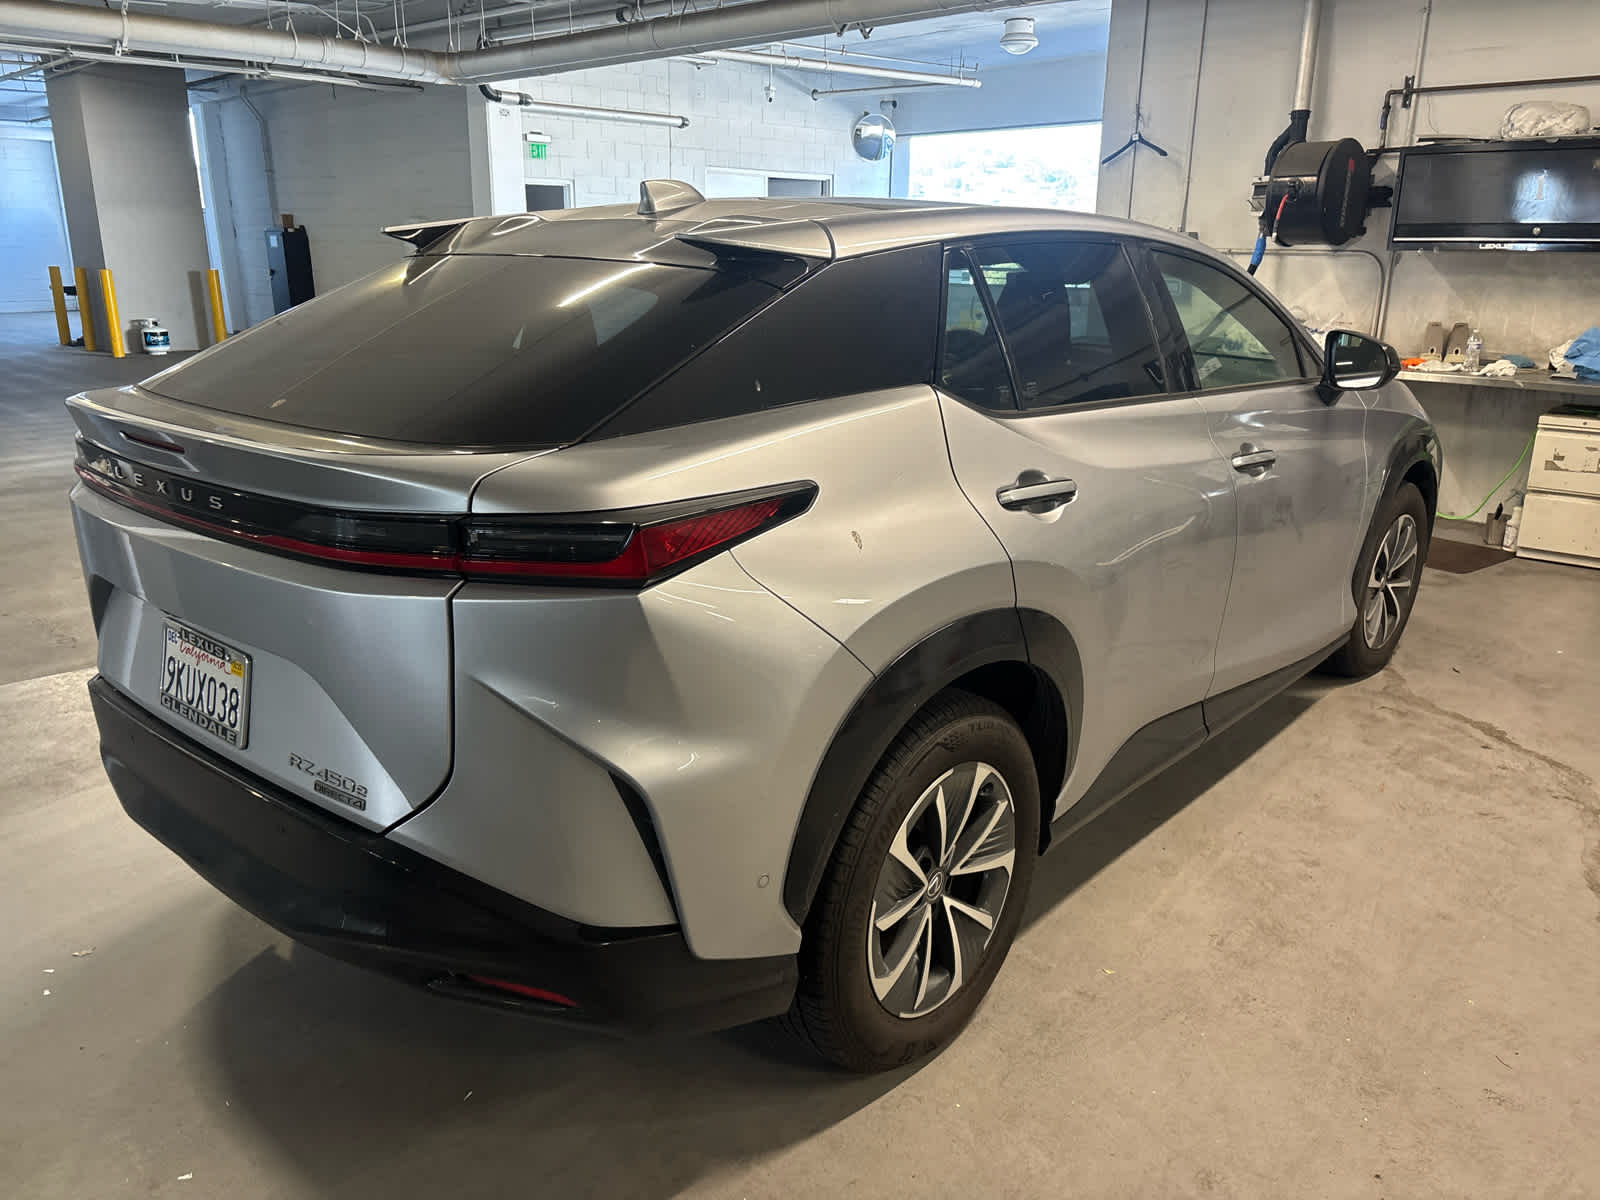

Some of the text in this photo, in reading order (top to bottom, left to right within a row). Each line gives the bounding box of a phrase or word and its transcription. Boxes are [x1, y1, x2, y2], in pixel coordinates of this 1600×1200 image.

[530, 143, 547, 160] EXIT
[114, 465, 224, 511] LEXUS
[180, 628, 226, 659] LEXUS
[165, 655, 240, 729] 9KUX038
[160, 693, 238, 745] GLENDALE
